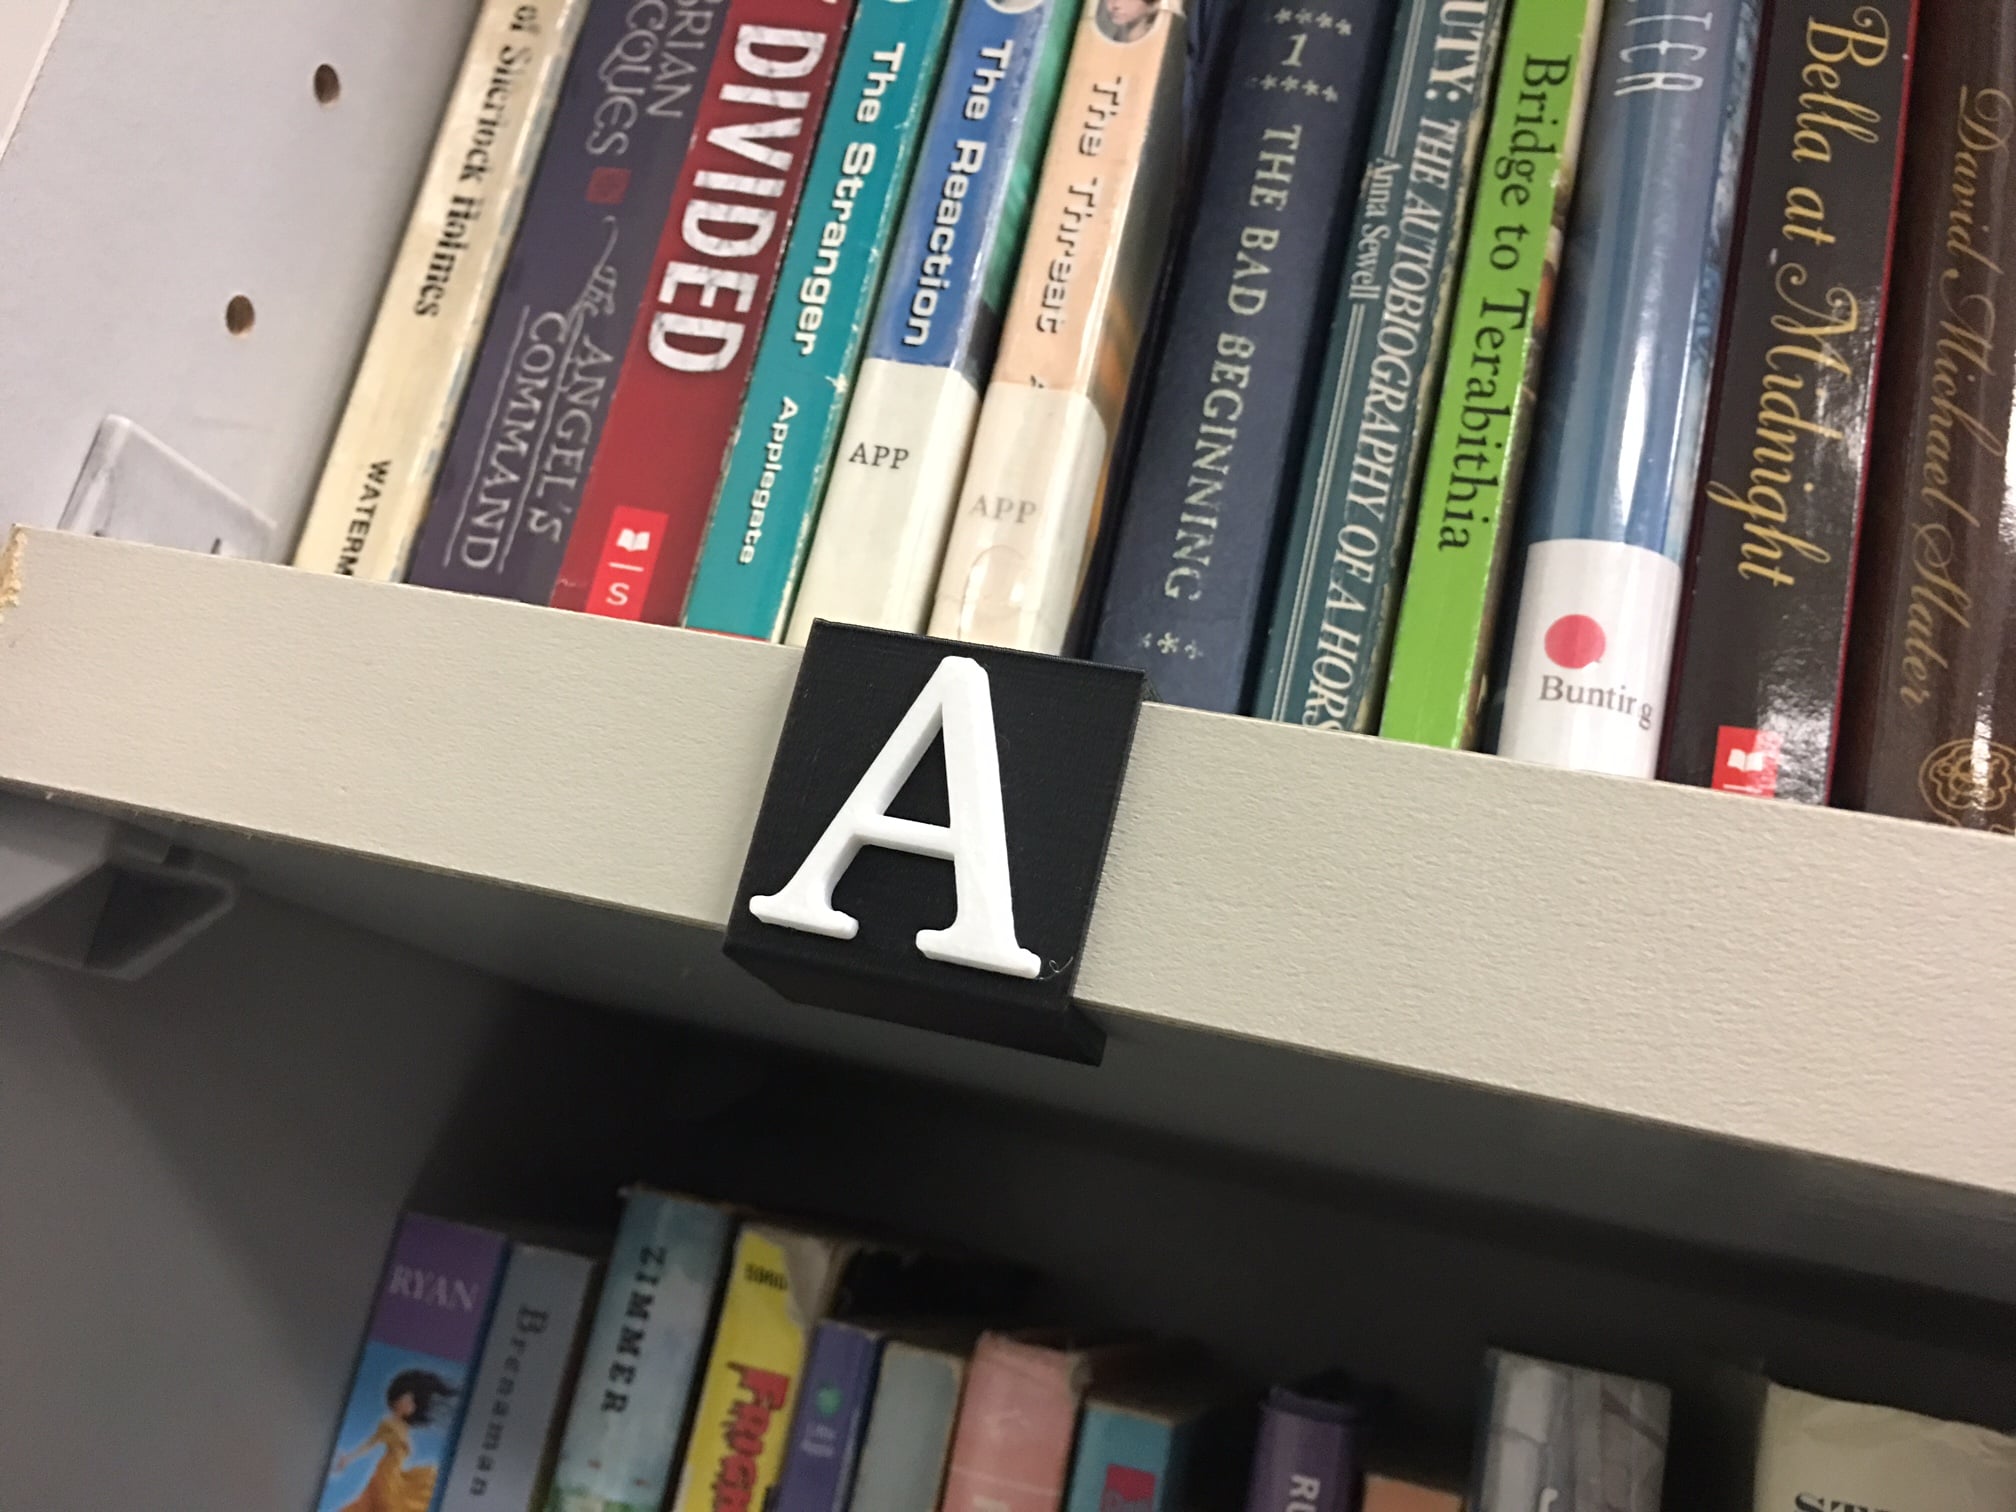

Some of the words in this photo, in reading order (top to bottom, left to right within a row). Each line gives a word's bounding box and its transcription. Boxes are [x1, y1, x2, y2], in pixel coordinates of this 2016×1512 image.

[645, 0, 718, 118] RIAN
[857, 42, 906, 123] The
[964, 39, 1014, 120] The
[1078, 75, 1123, 156] The
[1280, 33, 1308, 67] 1
[1791, 6, 1890, 163] Bella
[647, 24, 827, 373] DIVIDED
[1249, 124, 1303, 211] THE
[1365, 157, 1402, 217] Anna
[1408, 117, 1462, 190] THE
[1494, 53, 1571, 207] Bridge
[1947, 84, 2014, 275] David
[413, 194, 484, 318] Holmes
[794, 142, 877, 356] Stranger
[903, 139, 987, 347] Reaction
[1036, 176, 1103, 335] Threat
[1227, 227, 1281, 316] BAD
[1349, 223, 1391, 300] Sewell
[1489, 223, 1530, 271] to
[1782, 186, 1836, 245] at
[1346, 190, 1442, 523] AUTOBIOGRAPHY
[1438, 288, 1530, 552] Terabithia
[1706, 262, 1858, 588] Midnight
[1921, 268, 2004, 528] Michael
[460, 311, 567, 569] COMMAND
[527, 333, 615, 543] ANGEL'S
[738, 396, 798, 564] Applegate
[848, 442, 909, 470] APP
[1164, 332, 1256, 602] BEGINNING
[969, 494, 1037, 523] APP
[1335, 523, 1379, 584] OF
[605, 583, 631, 606] S
[1325, 581, 1367, 612] A
[1900, 522, 1972, 705] Slater
[749, 655, 1041, 979] A
[388, 1263, 480, 1313] RYAN
[602, 1246, 667, 1414] ZIMMER
[470, 1304, 549, 1498] Brenaman
